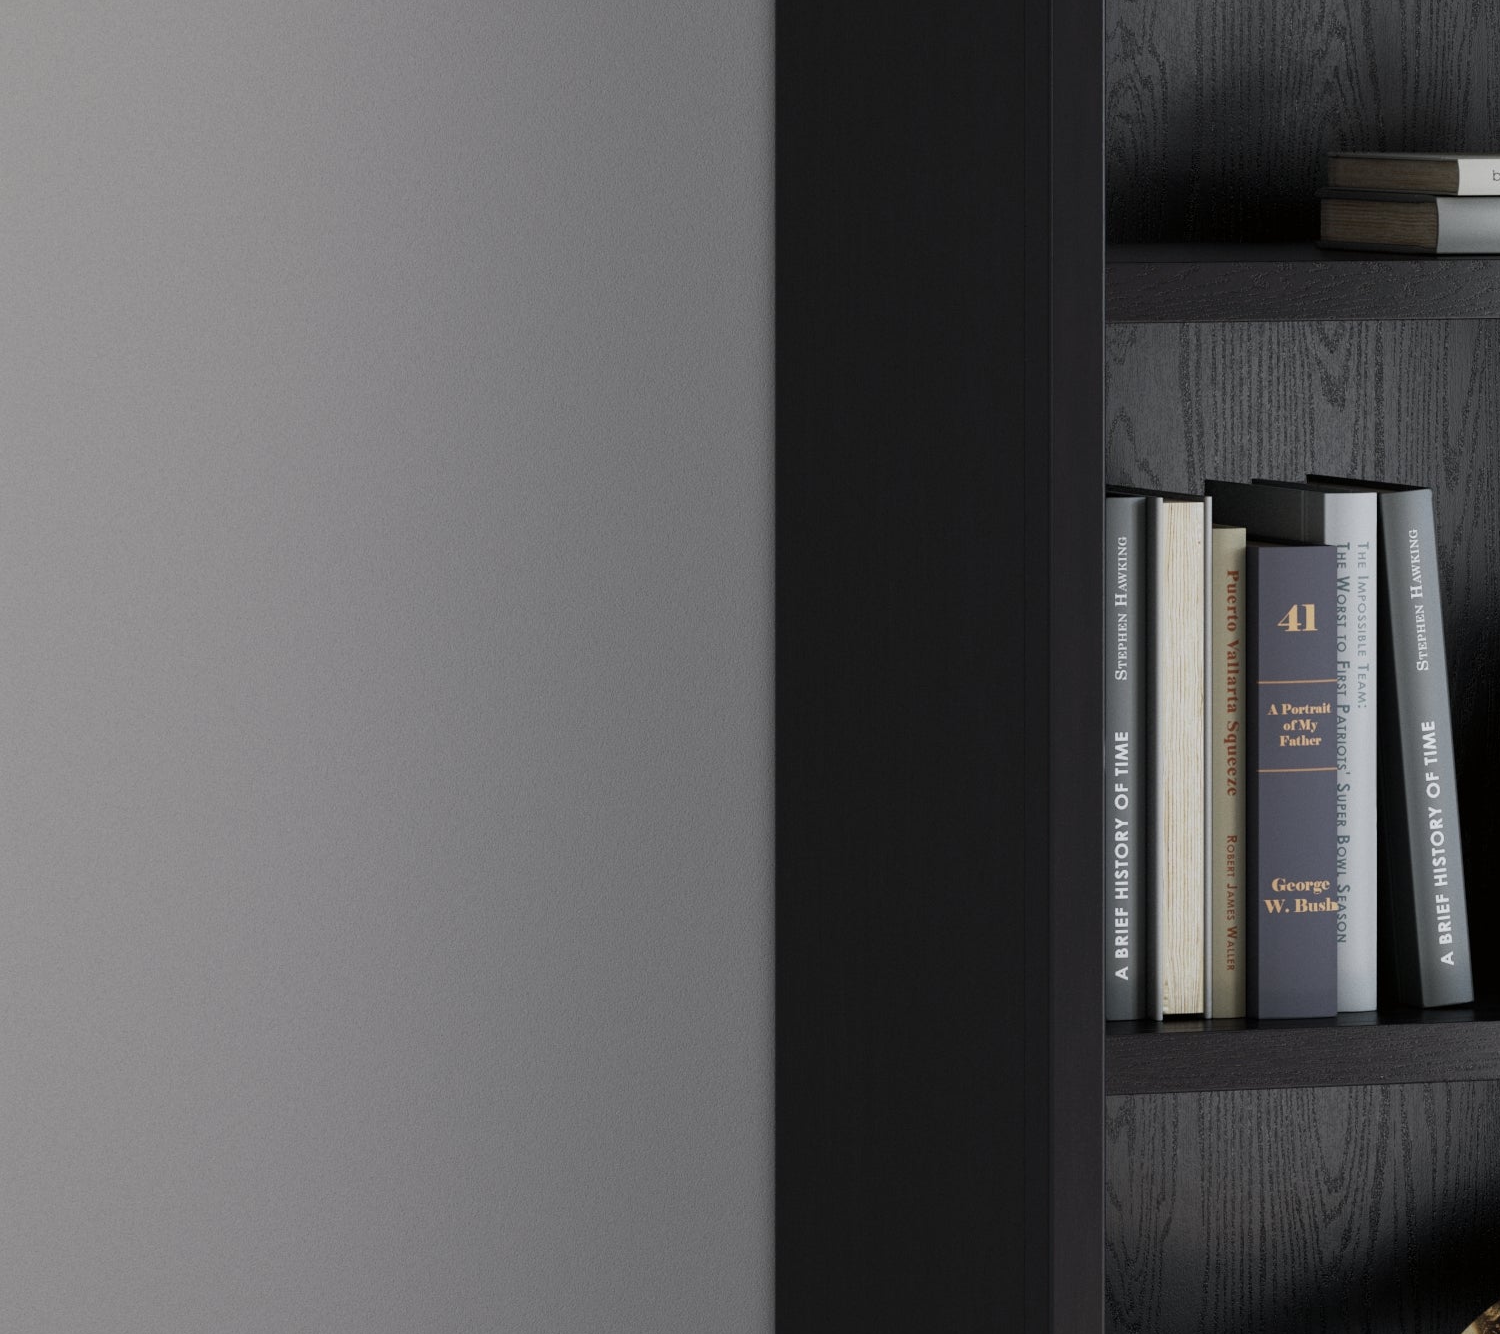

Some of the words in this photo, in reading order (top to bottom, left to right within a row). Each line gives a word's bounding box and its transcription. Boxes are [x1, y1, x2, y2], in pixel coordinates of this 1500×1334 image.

[1115, 536, 1128, 606] HAWKING
[1409, 529, 1423, 600] HAWKING
[1227, 570, 1240, 632] Puerto
[1277, 603, 1318, 631] 41
[1337, 576, 1350, 628] WORST
[1358, 576, 1369, 657] IMPOSSIBLE
[1115, 613, 1128, 681] STEPHEN
[1415, 605, 1428, 671] STEPHEN
[1227, 639, 1240, 713] Vallarta
[1337, 661, 1350, 696] FIRST
[1267, 703, 1278, 715] A
[1282, 703, 1331, 715] Portrait
[1283, 719, 1298, 731] of
[1299, 719, 1318, 732] My
[1115, 731, 1129, 776] TIME
[1224, 721, 1239, 796] Squeeze
[1280, 735, 1322, 747] Father
[1421, 721, 1438, 765] TIME
[1115, 783, 1129, 810] OF
[1337, 783, 1350, 827] SUPER
[1426, 772, 1440, 798] OF
[1115, 818, 1129, 899] HISTORY
[1227, 835, 1238, 877] ROBERT
[1428, 806, 1448, 887] HISTORY
[1227, 883, 1238, 920] JAMES
[1264, 899, 1290, 913] W.
[1294, 897, 1340, 913] Bush
[1271, 877, 1330, 895] George
[1115, 907, 1129, 958] BRIEF
[1435, 894, 1453, 945] BRIEF
[1227, 926, 1237, 971] WALLER
[1440, 951, 1454, 965] A
[1115, 966, 1128, 980] A
